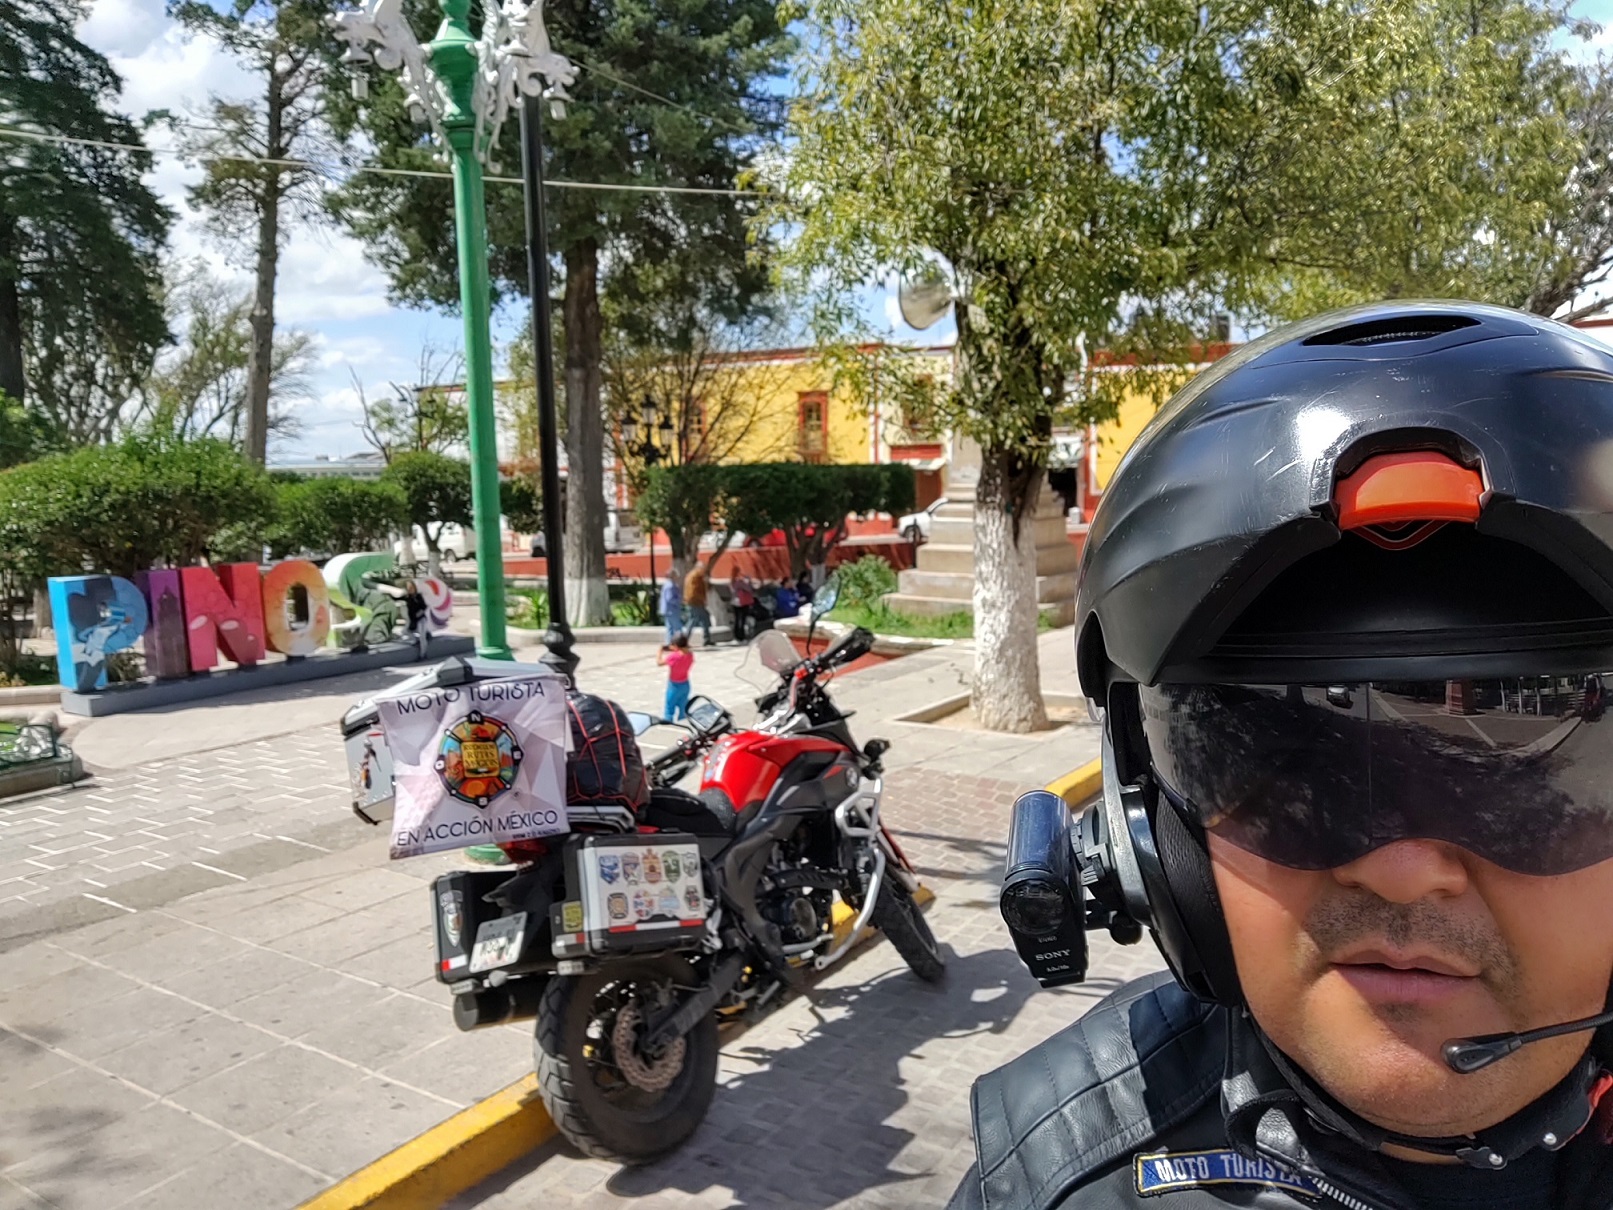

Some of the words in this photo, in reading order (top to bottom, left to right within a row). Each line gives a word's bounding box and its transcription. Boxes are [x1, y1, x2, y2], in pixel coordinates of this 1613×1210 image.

[47, 552, 397, 693] PINOS
[397, 687, 461, 715] MOTO
[469, 681, 545, 702] TURISTA
[397, 830, 422, 846] EN
[424, 816, 493, 842] ACCIÓN
[497, 810, 558, 831] MÉXICO
[1035, 949, 1070, 961] SONY
[1154, 1157, 1211, 1183] MOTO
